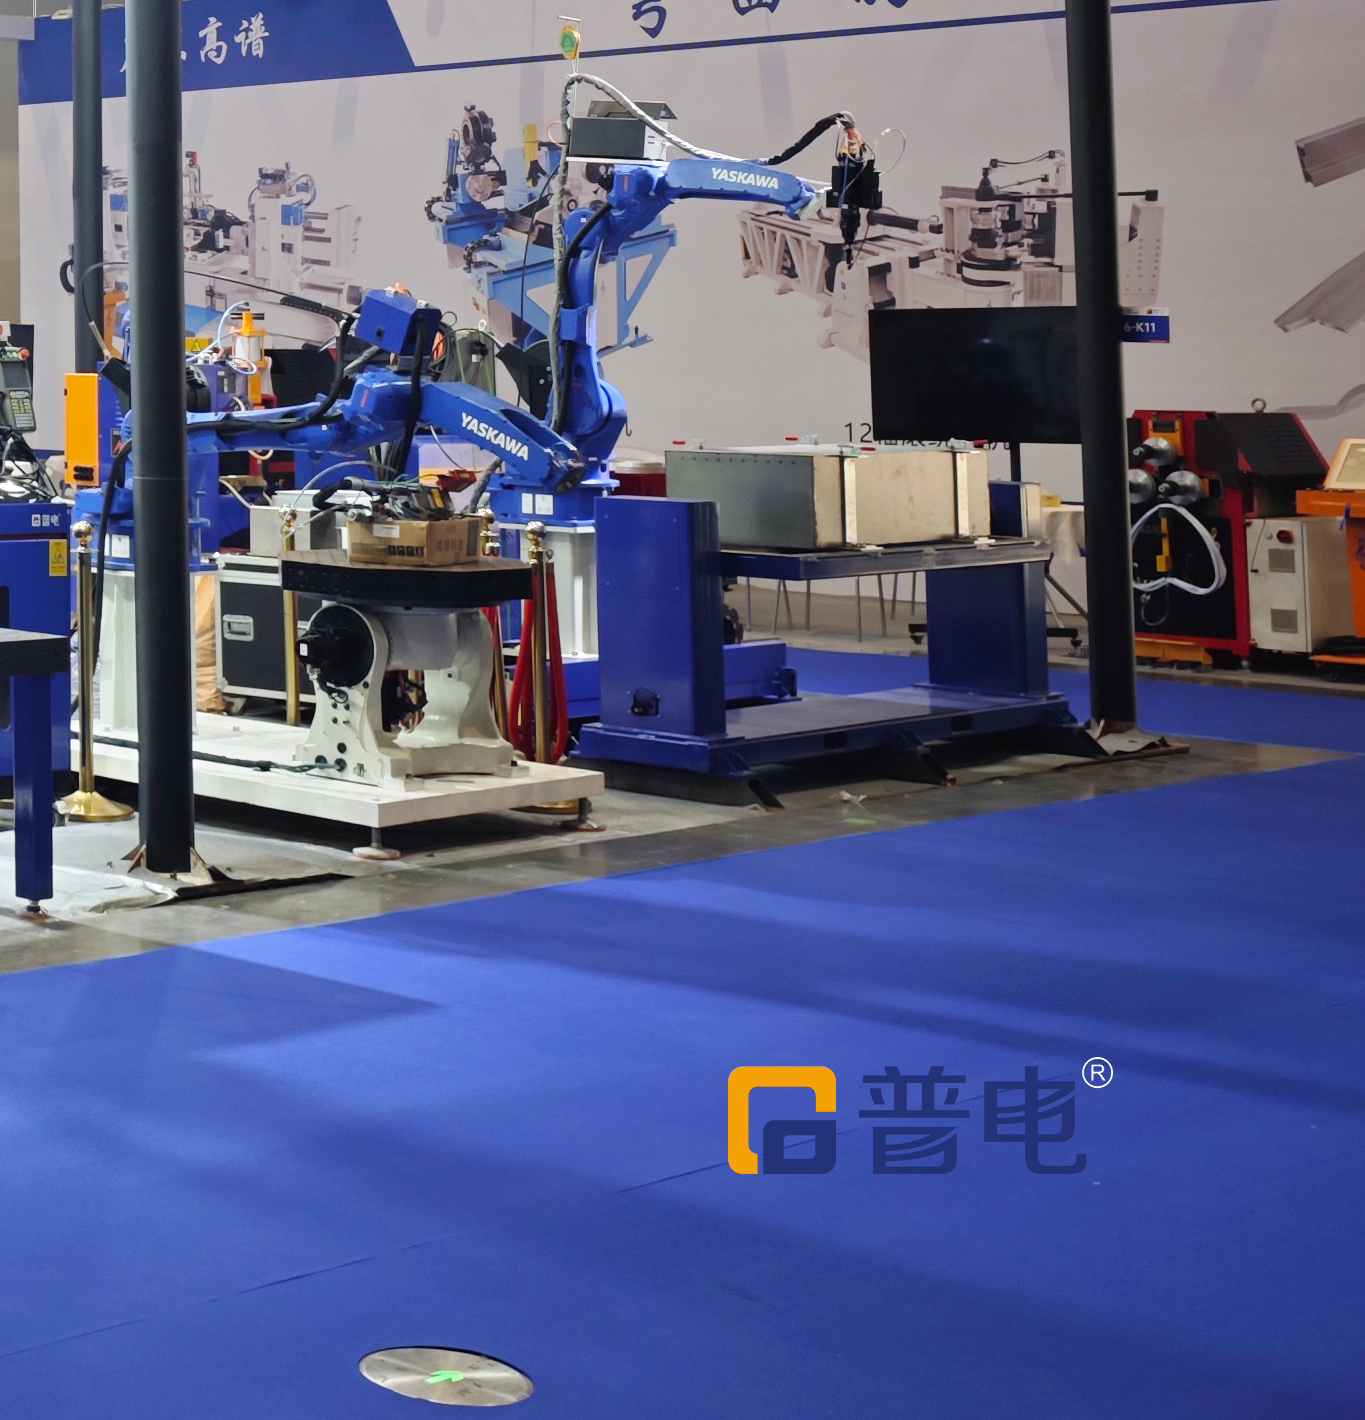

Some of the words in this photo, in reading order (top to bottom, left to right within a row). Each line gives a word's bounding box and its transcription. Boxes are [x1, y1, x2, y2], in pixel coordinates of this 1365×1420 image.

[711, 166, 780, 190] YASKAWA
[1124, 322, 1156, 333] 6-K11
[461, 412, 529, 461] YASKAWA
